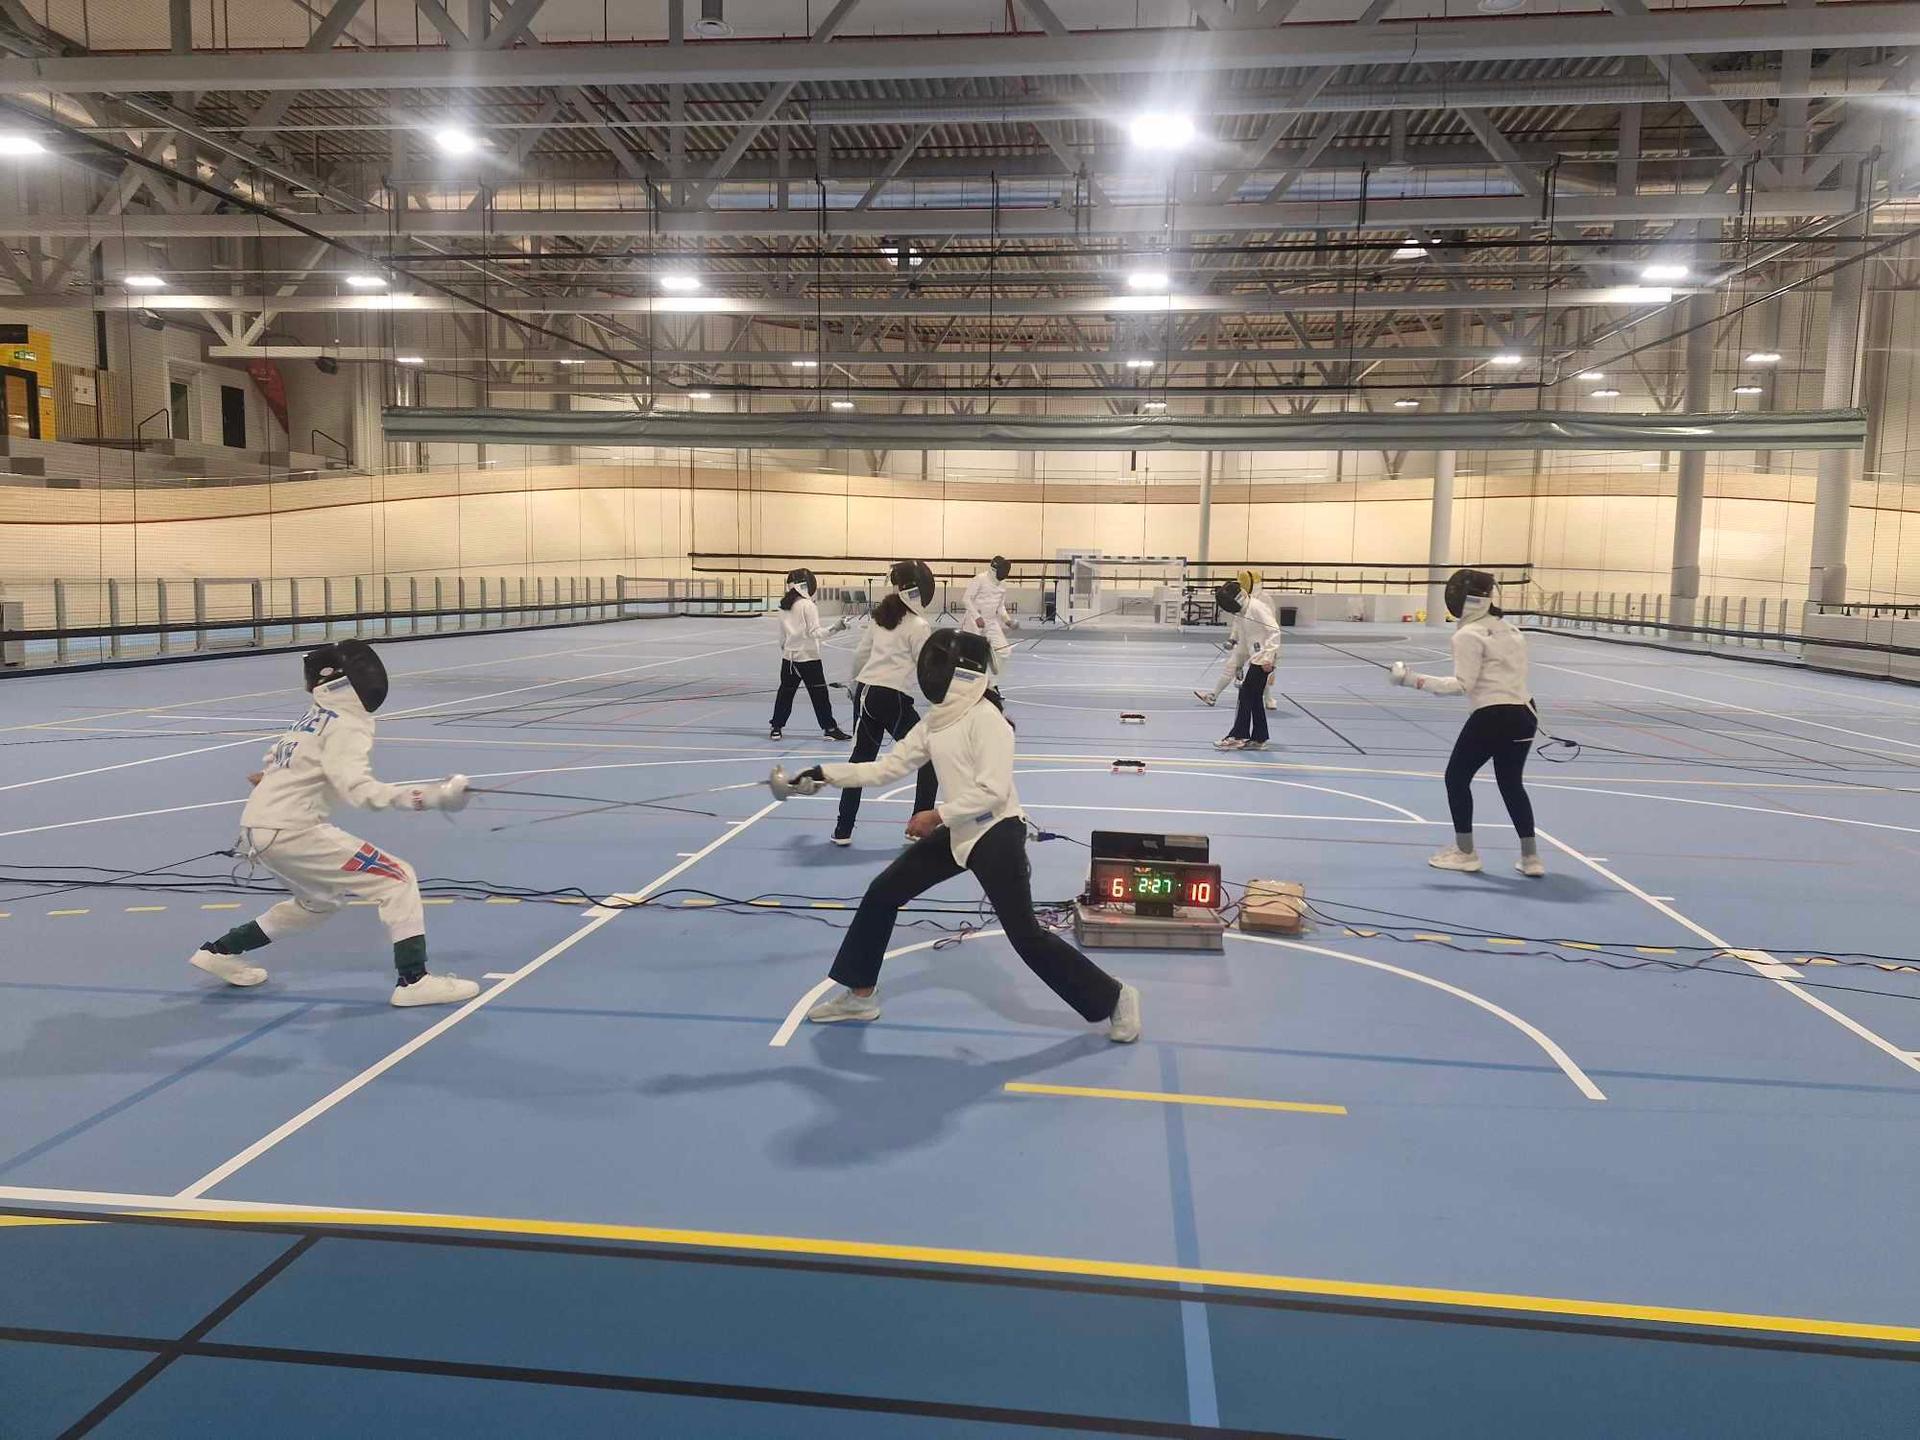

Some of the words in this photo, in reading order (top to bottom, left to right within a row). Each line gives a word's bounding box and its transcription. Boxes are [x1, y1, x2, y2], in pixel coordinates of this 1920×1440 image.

[1112, 878, 1124, 898] 6
[1138, 877, 1172, 894] 2:27
[1191, 882, 1211, 904] 10
